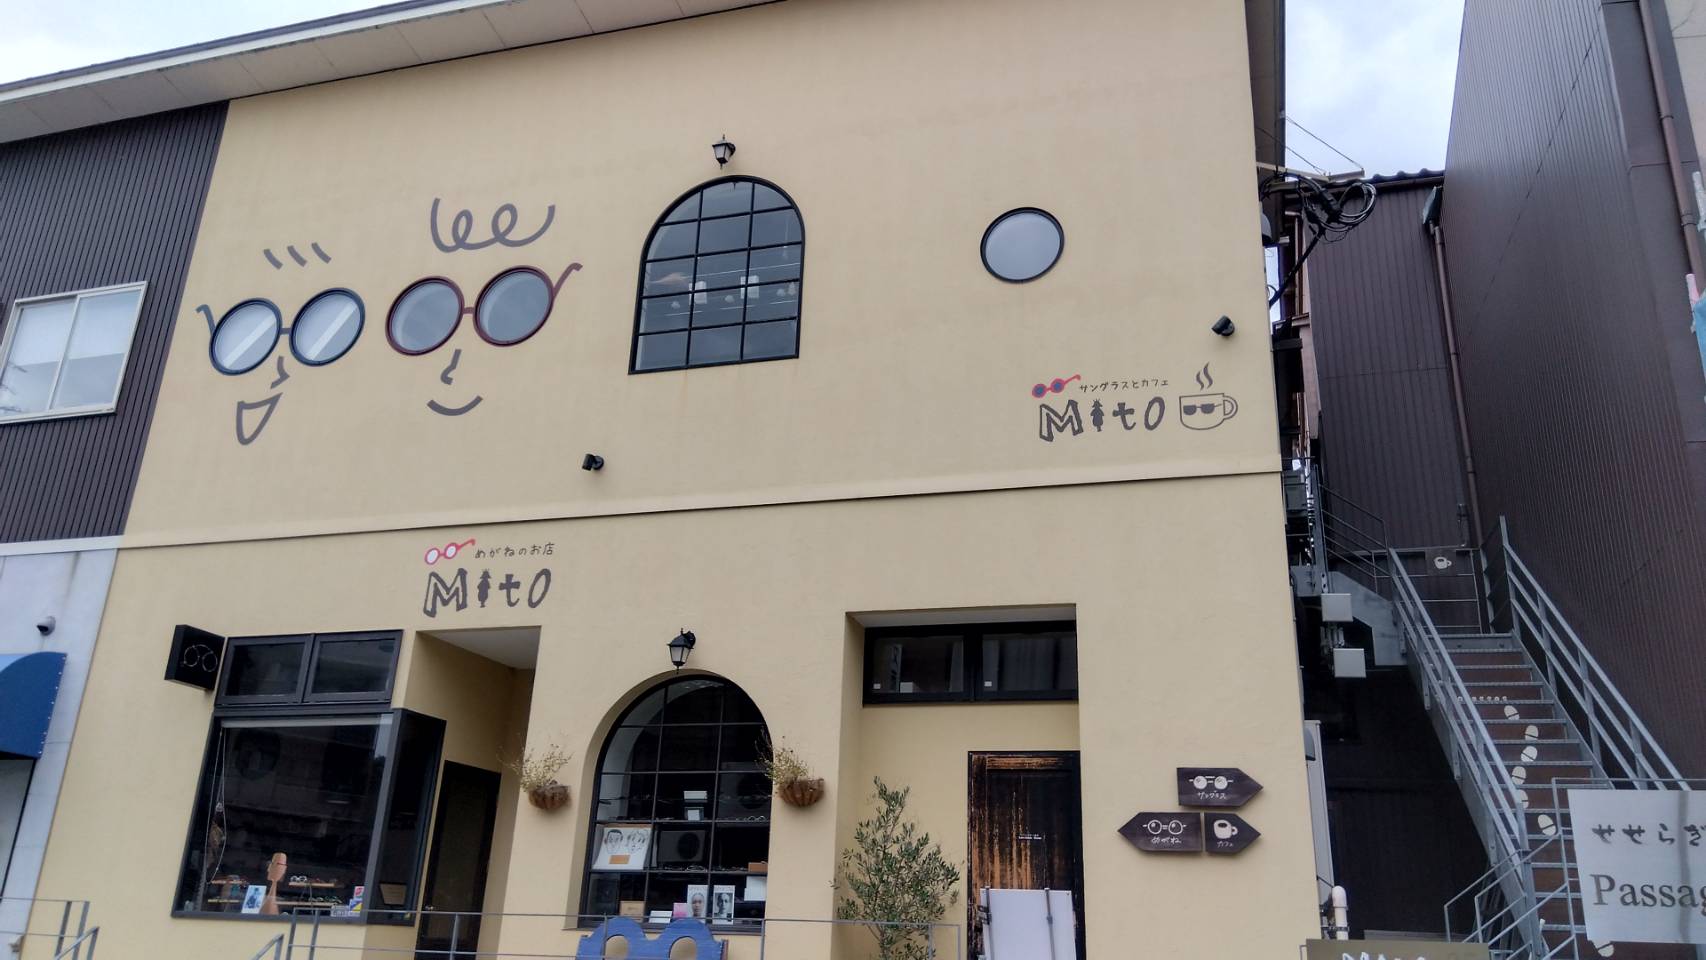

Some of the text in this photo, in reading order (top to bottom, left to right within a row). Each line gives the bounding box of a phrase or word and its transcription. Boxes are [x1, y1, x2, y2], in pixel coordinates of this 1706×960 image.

[1079, 378, 1169, 393] サングラスとカフェ
[474, 541, 555, 559] めがねのお店
[1151, 836, 1182, 845] めがね
